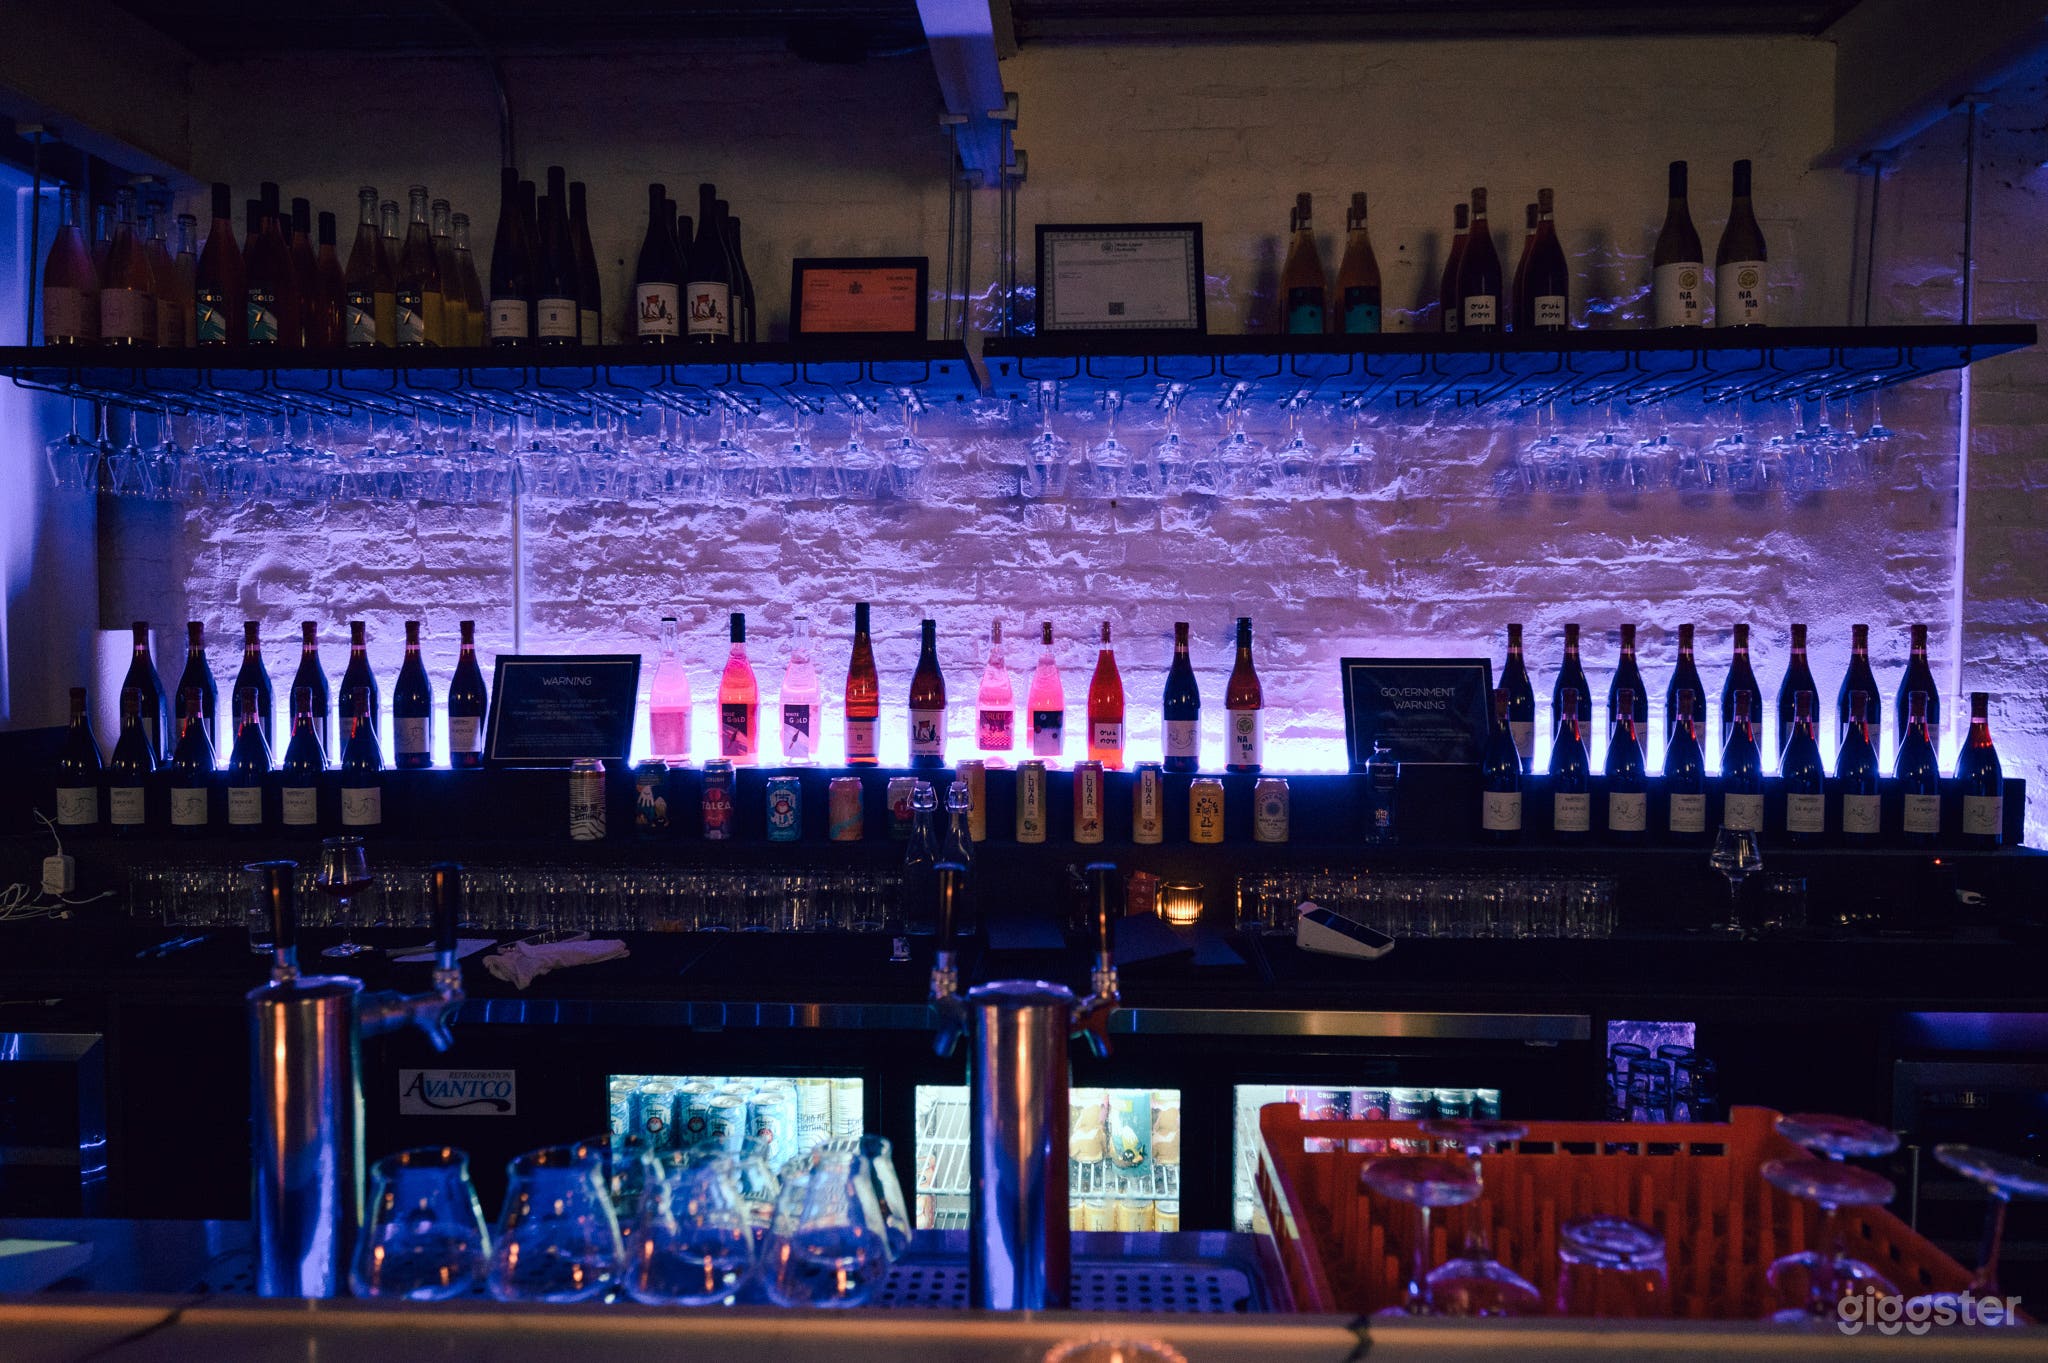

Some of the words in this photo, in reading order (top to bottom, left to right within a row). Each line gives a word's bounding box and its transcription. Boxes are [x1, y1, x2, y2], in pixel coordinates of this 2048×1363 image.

[1680, 291, 1692, 300] NA
[1738, 290, 1752, 299] NA
[1685, 301, 1697, 309] MA
[1745, 300, 1758, 308] MA
[542, 676, 593, 686] WARNING
[1380, 687, 1456, 697] GOVERNMENT
[1393, 700, 1447, 710] WARNING
[1237, 735, 1248, 743] NA
[448, 1071, 512, 1079] REFRIGERATION
[403, 1072, 512, 1100] AVANTCO
[1317, 1091, 1340, 1099] CRUSH
[1398, 1106, 1421, 1115] CRUSH
[1437, 1107, 1460, 1116] CRUSH
